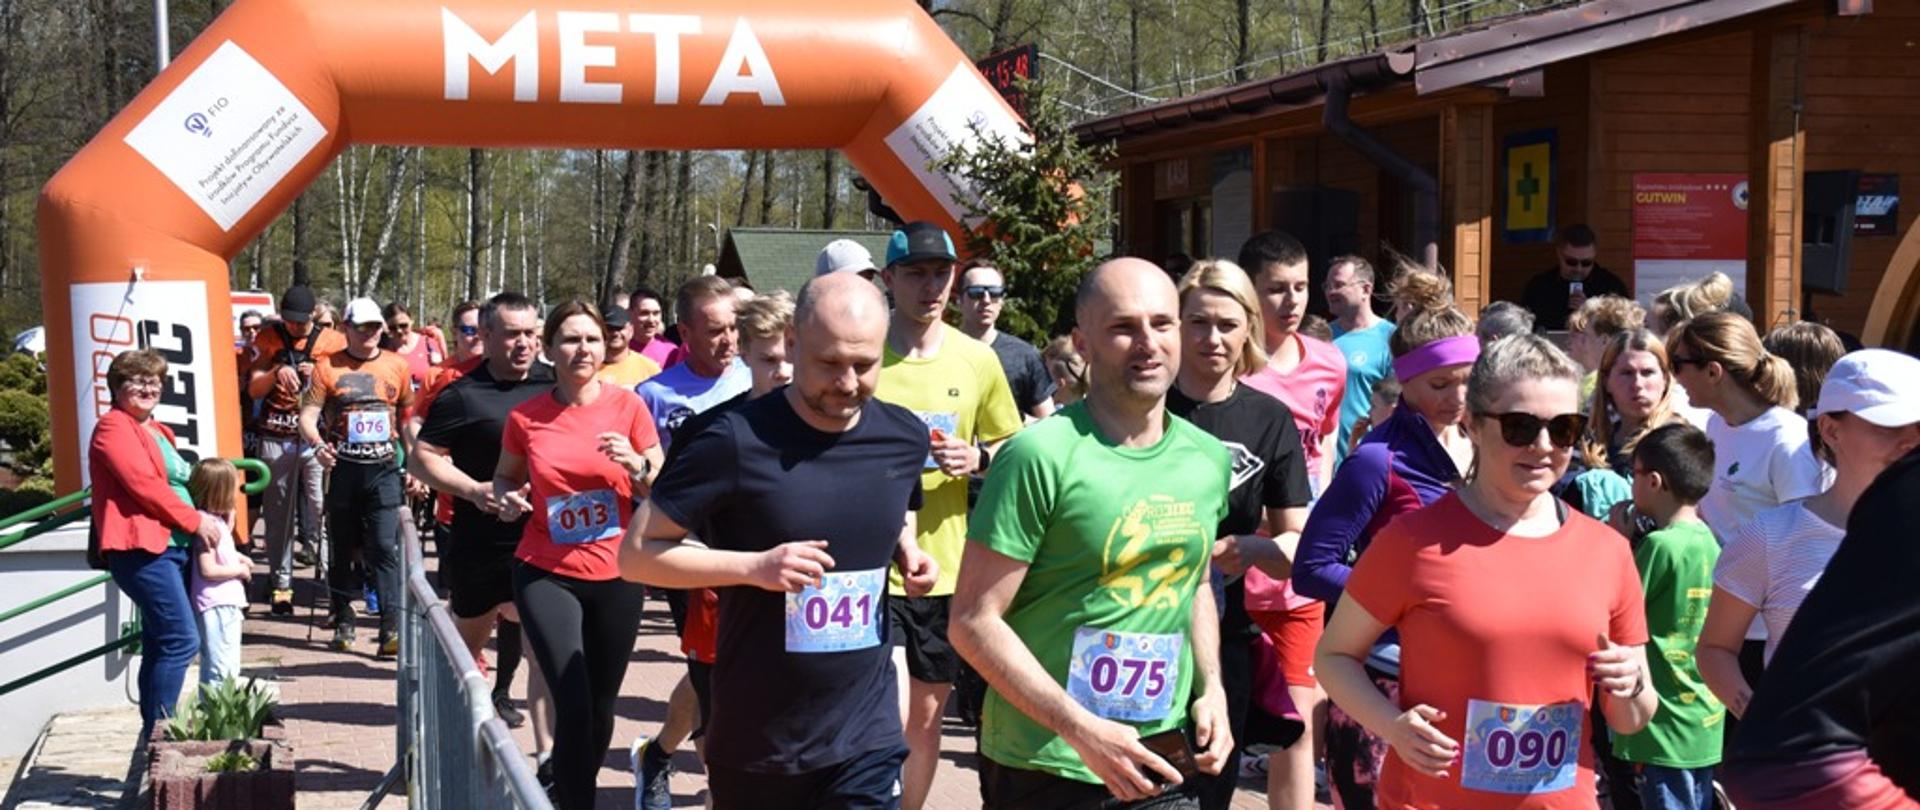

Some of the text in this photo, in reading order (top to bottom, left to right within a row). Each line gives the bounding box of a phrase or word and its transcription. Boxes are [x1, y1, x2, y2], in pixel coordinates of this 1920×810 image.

[441, 5, 786, 106] META
[208, 97, 229, 117] FIO
[199, 163, 225, 188] Projekt
[225, 116, 277, 165] dofinansowany
[235, 141, 270, 172] Programu
[268, 113, 298, 140] Fundusz
[252, 127, 303, 174] Obywatelskich
[1636, 192, 1687, 204] GUTWIN
[356, 421, 384, 434] 076
[560, 503, 609, 530] 013
[805, 594, 871, 630] 041
[1090, 655, 1167, 698] 075
[1486, 728, 1567, 769] 090
